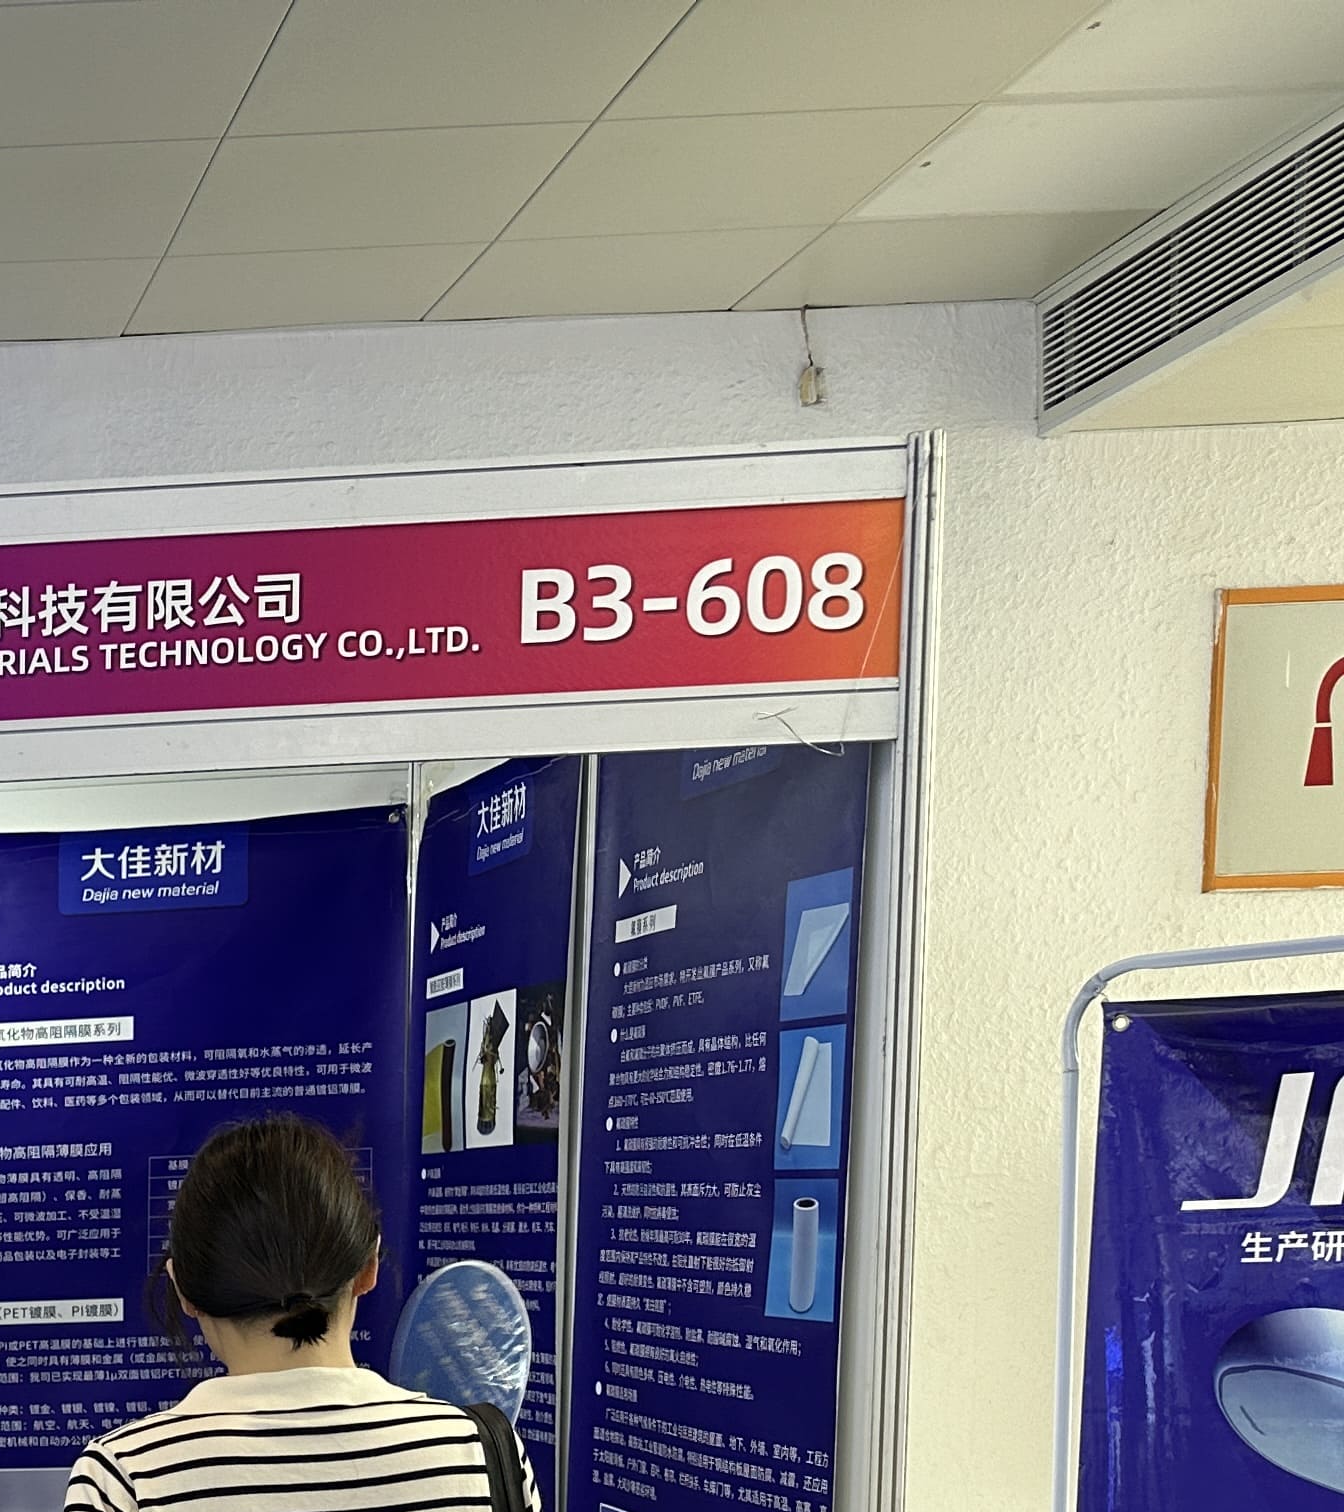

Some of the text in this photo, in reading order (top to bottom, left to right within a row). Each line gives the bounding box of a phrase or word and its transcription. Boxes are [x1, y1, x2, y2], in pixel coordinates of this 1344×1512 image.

[520, 551, 865, 645] B3-608
[98, 631, 328, 672] TECHNOLOGY
[336, 626, 480, 661] CO.,LTD.
[692, 762, 711, 783] Dajia
[713, 756, 732, 773] new
[476, 782, 527, 838] 大佳新材
[81, 840, 225, 882] 大佳新材
[633, 847, 661, 870] 产品简介
[82, 881, 219, 904] Dajia new material
[633, 860, 704, 894] Product description
[40, 976, 125, 996] description
